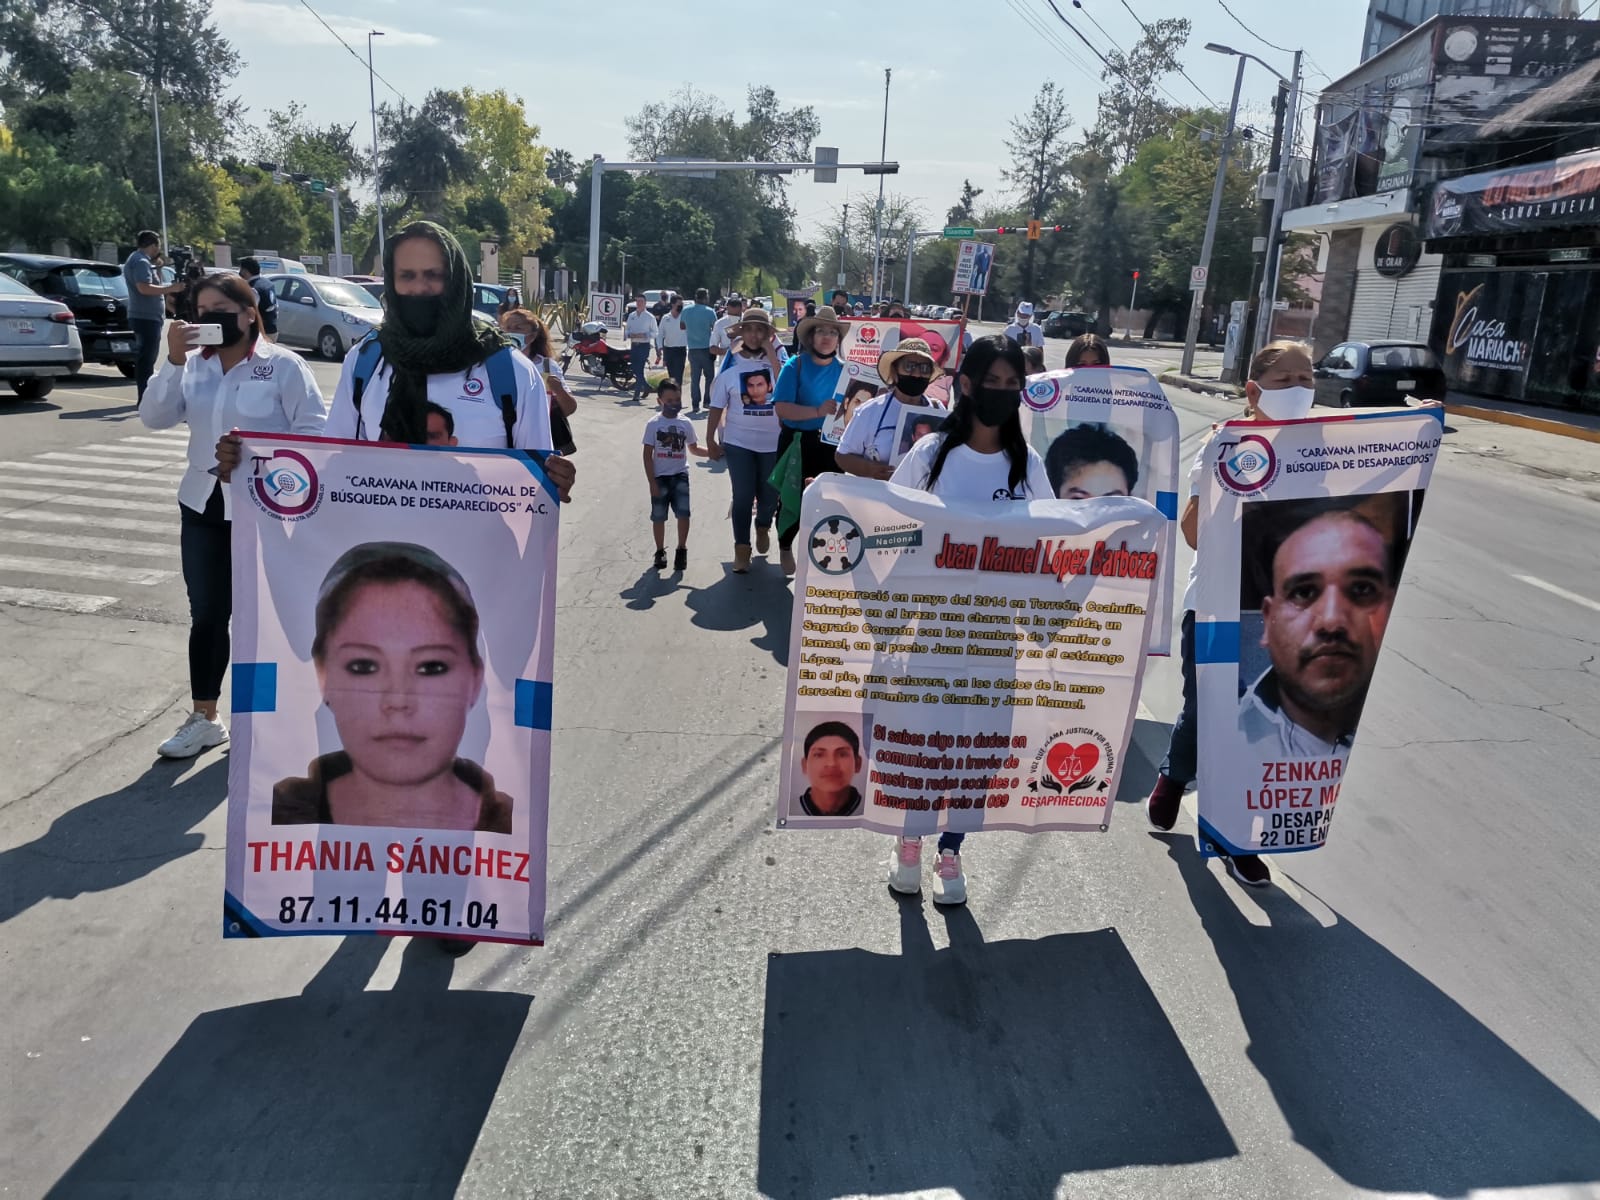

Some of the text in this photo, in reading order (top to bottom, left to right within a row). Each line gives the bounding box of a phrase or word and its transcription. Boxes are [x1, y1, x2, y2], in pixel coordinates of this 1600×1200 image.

[1501, 197, 1595, 220] SOMOS NUEVA
[1453, 306, 1506, 348] Casa
[1102, 397, 1111, 405] DE
[1286, 460, 1341, 474] BÚSQUEDA
[1342, 459, 1355, 470] DE
[421, 480, 517, 497] INTERNACIONAL
[520, 486, 536, 497] DE
[330, 488, 397, 506] BÚSQUEDA
[400, 496, 416, 507] DE
[525, 503, 549, 515] A.C.
[873, 521, 918, 533] Búsqueda
[875, 534, 918, 546] Nacional
[935, 533, 1158, 583] Juan Manuel López Barboza
[806, 586, 1147, 616] Desapareció en mayo del 2014 en Torreón, Coahuila.
[804, 603, 1122, 631] Tatuajes en el brazo una charra en la espalda, un
[803, 620, 1112, 646] Sagrado Corazón con los nombres de Yennifer e
[800, 653, 845, 667] López.
[801, 637, 1125, 666] Ismael, en el pecho Juan Manuel y en el estómago
[799, 669, 817, 680] En
[819, 669, 833, 680] el
[863, 674, 888, 684] una
[890, 674, 950, 689] calavera,
[953, 678, 969, 688] en
[971, 677, 991, 689] los
[994, 678, 1033, 690] dedos
[1034, 679, 1052, 691] de
[1053, 680, 1067, 692] la
[1069, 684, 1106, 695] mano
[797, 685, 1087, 709] derecha el nombre de Claudia y Juan Manuel.
[887, 728, 926, 747] sabes
[927, 731, 955, 752] algo
[956, 735, 973, 749] no
[973, 732, 1011, 749] dudes
[1011, 735, 1028, 749] en
[1065, 727, 1094, 736] JUSTICIA
[1093, 731, 1107, 744] POR
[1102, 741, 1115, 774] PERSONAS
[875, 749, 1020, 770] comunicarte a través de
[869, 769, 1020, 791] nuestras redes sociales o
[872, 789, 931, 811] llamando
[931, 795, 973, 811] directo
[973, 794, 987, 809] al
[1246, 784, 1313, 810] LÓPEZ
[1260, 831, 1279, 847] 22
[1285, 829, 1305, 845] DE
[247, 836, 530, 883] THANIA SÁNCHEZ
[278, 896, 499, 930] 87.11.44.61.04
